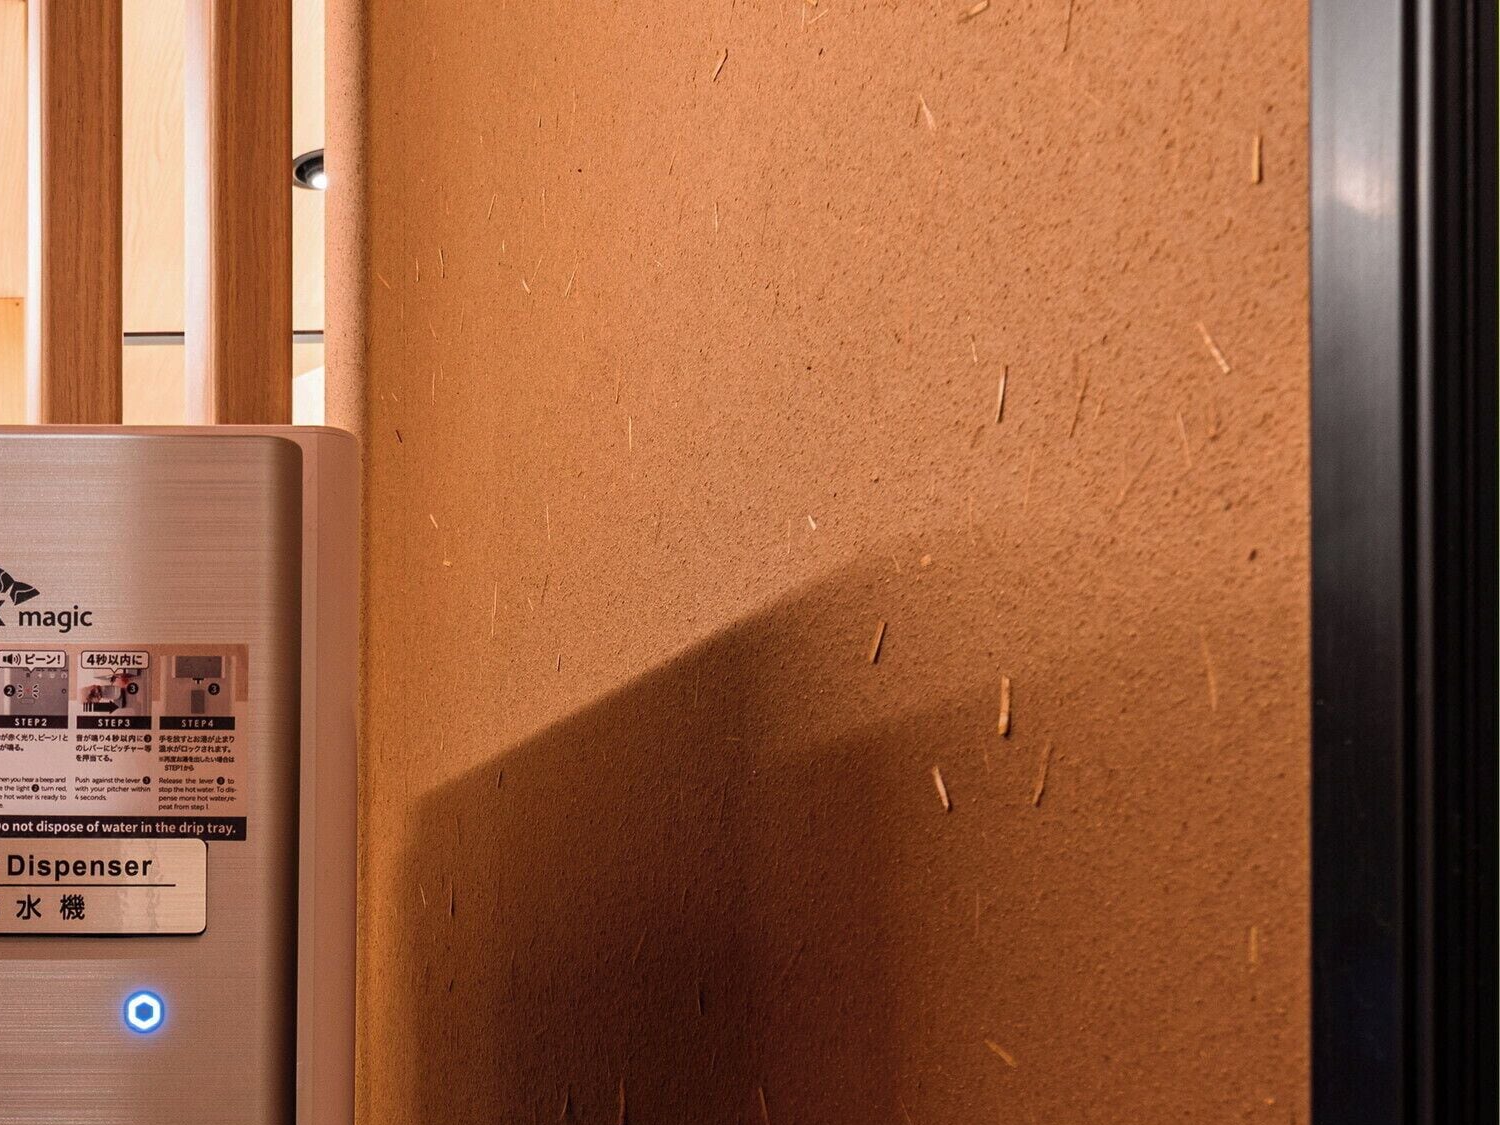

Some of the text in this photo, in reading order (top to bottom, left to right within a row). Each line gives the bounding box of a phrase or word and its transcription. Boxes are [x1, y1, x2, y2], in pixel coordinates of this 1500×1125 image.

[18, 604, 93, 633] magic
[86, 653, 143, 666] 4秒以内に
[14, 718, 48, 727] STEP2
[97, 718, 131, 727] STEP3
[181, 718, 215, 728] STEP4
[39, 776, 54, 784] beep
[92, 777, 114, 785] against
[16, 785, 30, 793] light
[159, 786, 173, 794] stop
[41, 794, 59, 802] ready
[12, 821, 34, 832] not
[36, 820, 84, 835] dispose
[86, 820, 100, 833] of
[102, 822, 138, 833] water
[141, 821, 152, 833] in
[155, 822, 176, 833] the
[179, 821, 204, 836] drip
[207, 823, 237, 836] tray.
[6, 854, 153, 881] Dispenser
